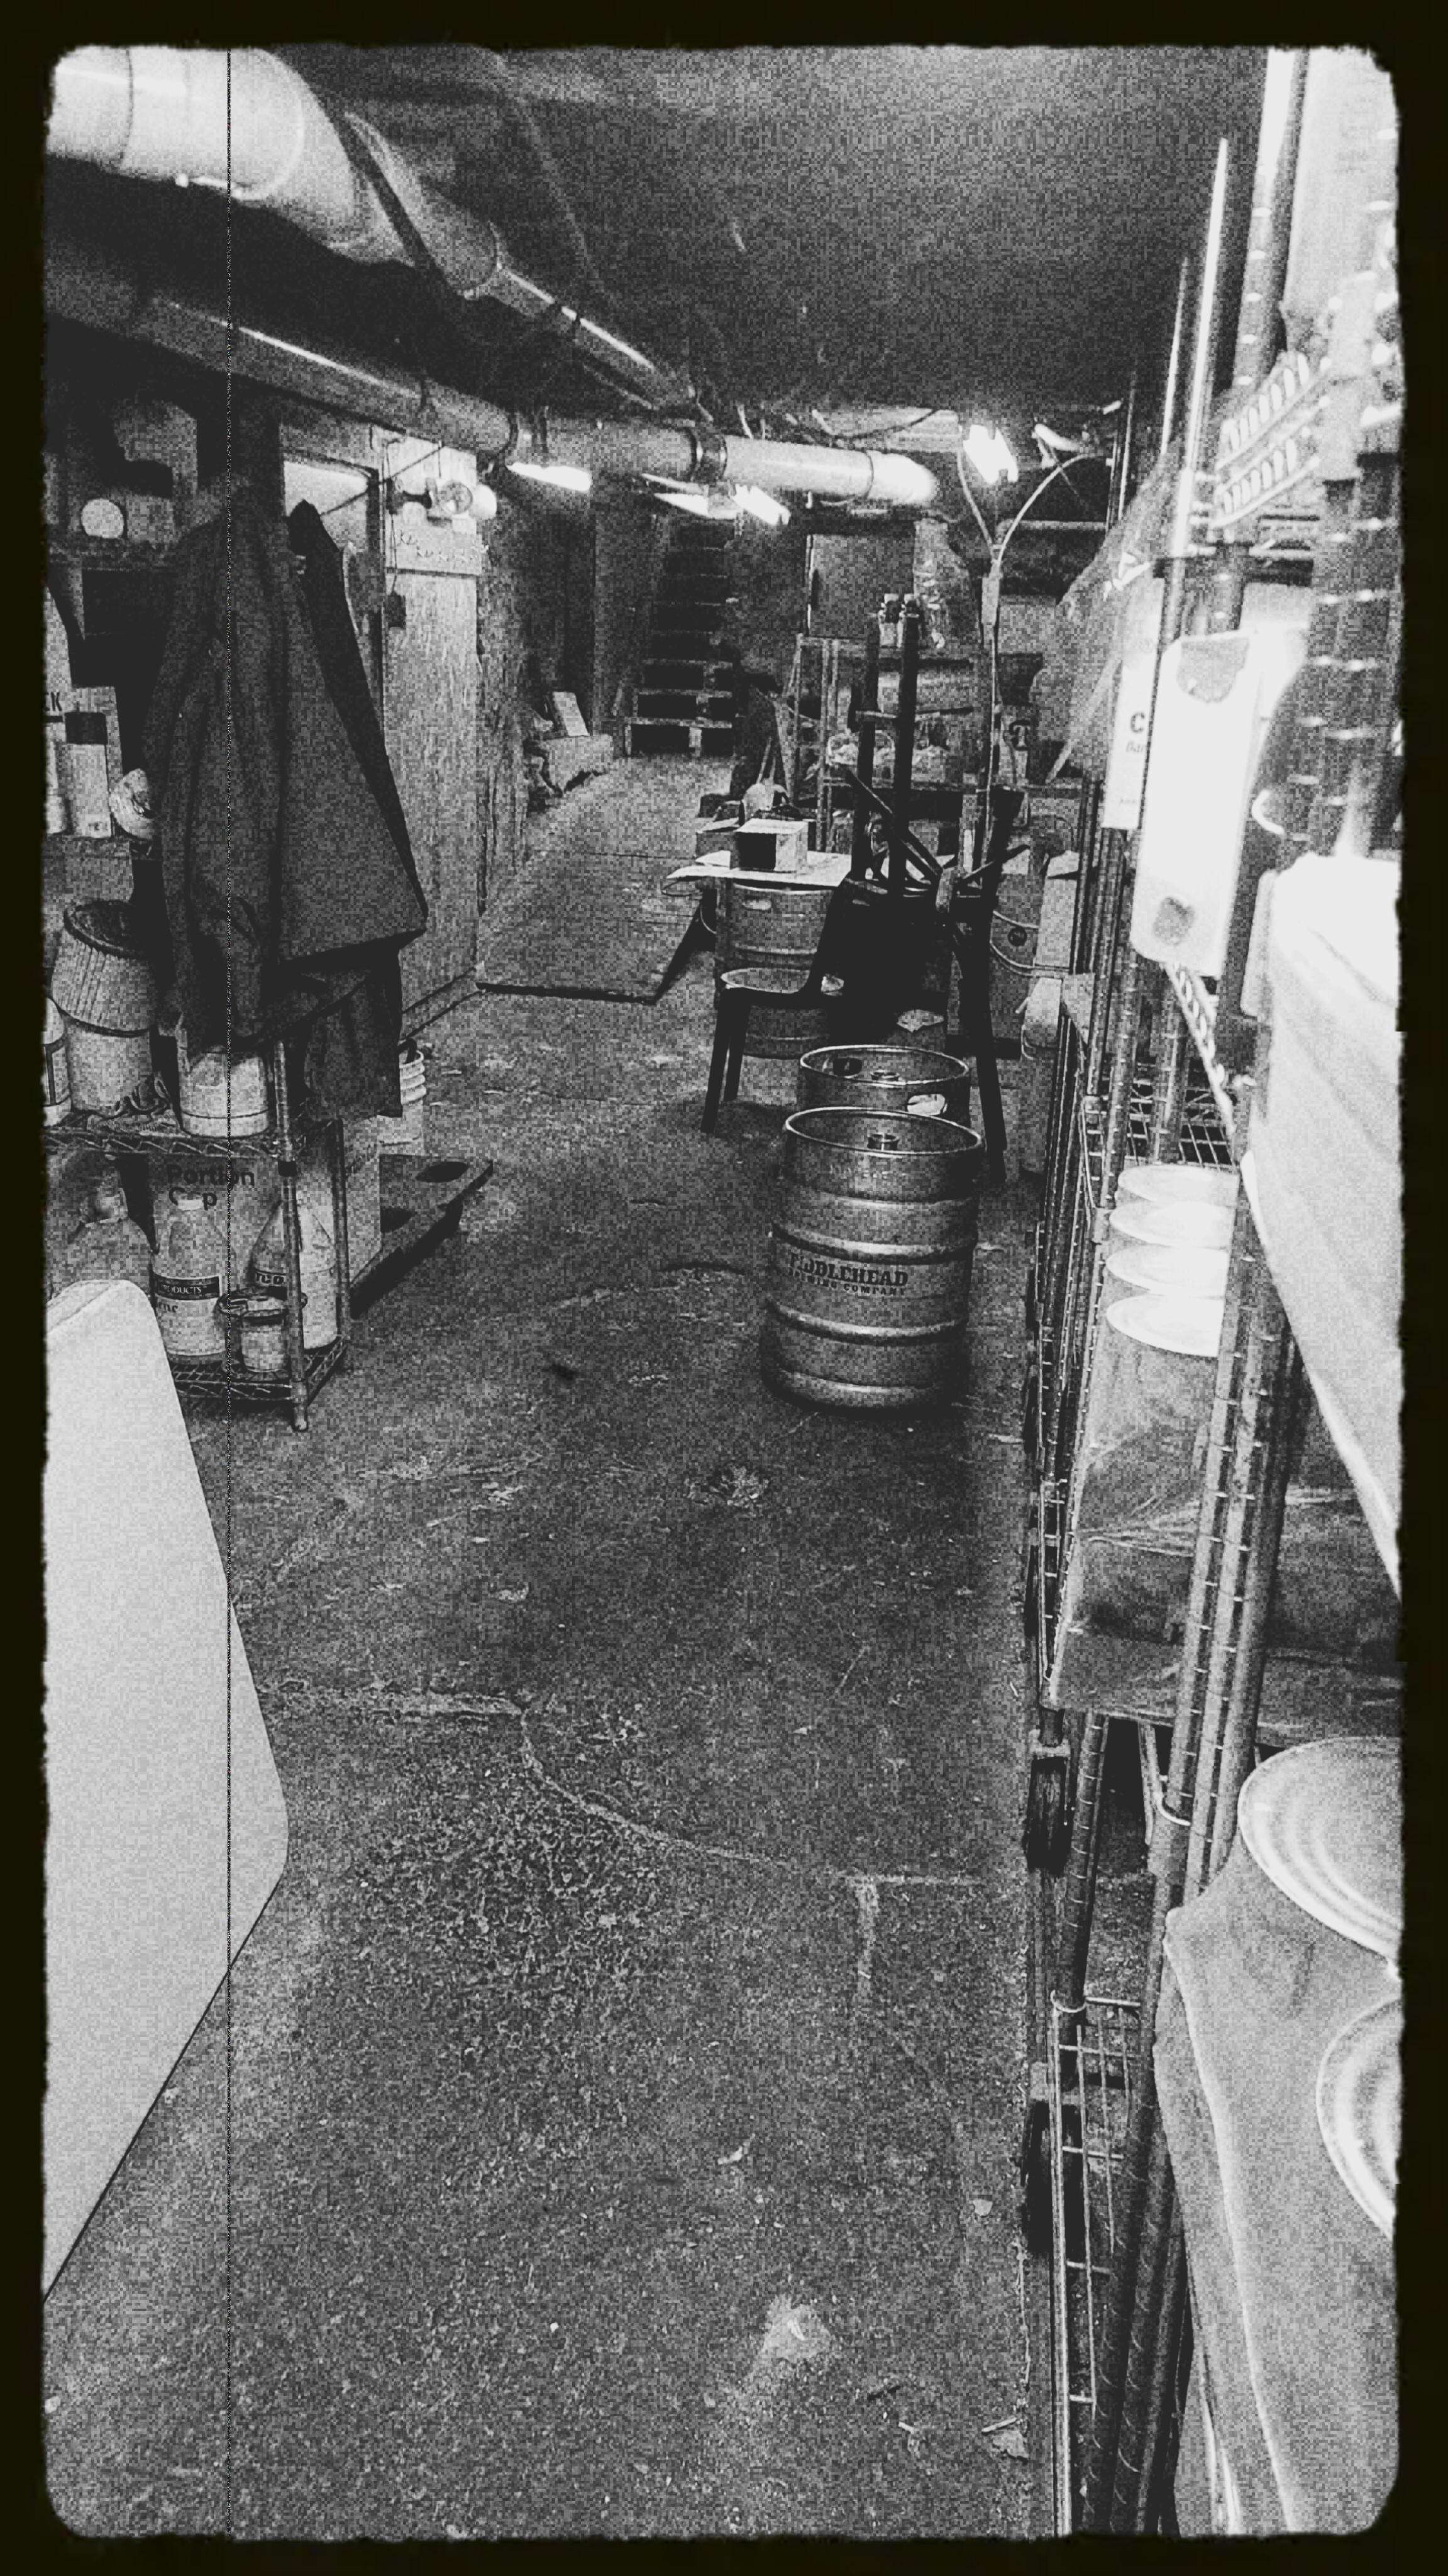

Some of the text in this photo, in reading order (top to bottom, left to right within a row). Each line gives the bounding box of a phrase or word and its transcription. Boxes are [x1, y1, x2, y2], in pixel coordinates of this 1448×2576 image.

[167, 1164, 255, 1187] Portion
[169, 1186, 218, 1211] Cp
[790, 1252, 909, 1286] FIDDLEHEAD
[843, 1283, 906, 1296] COMPANY
